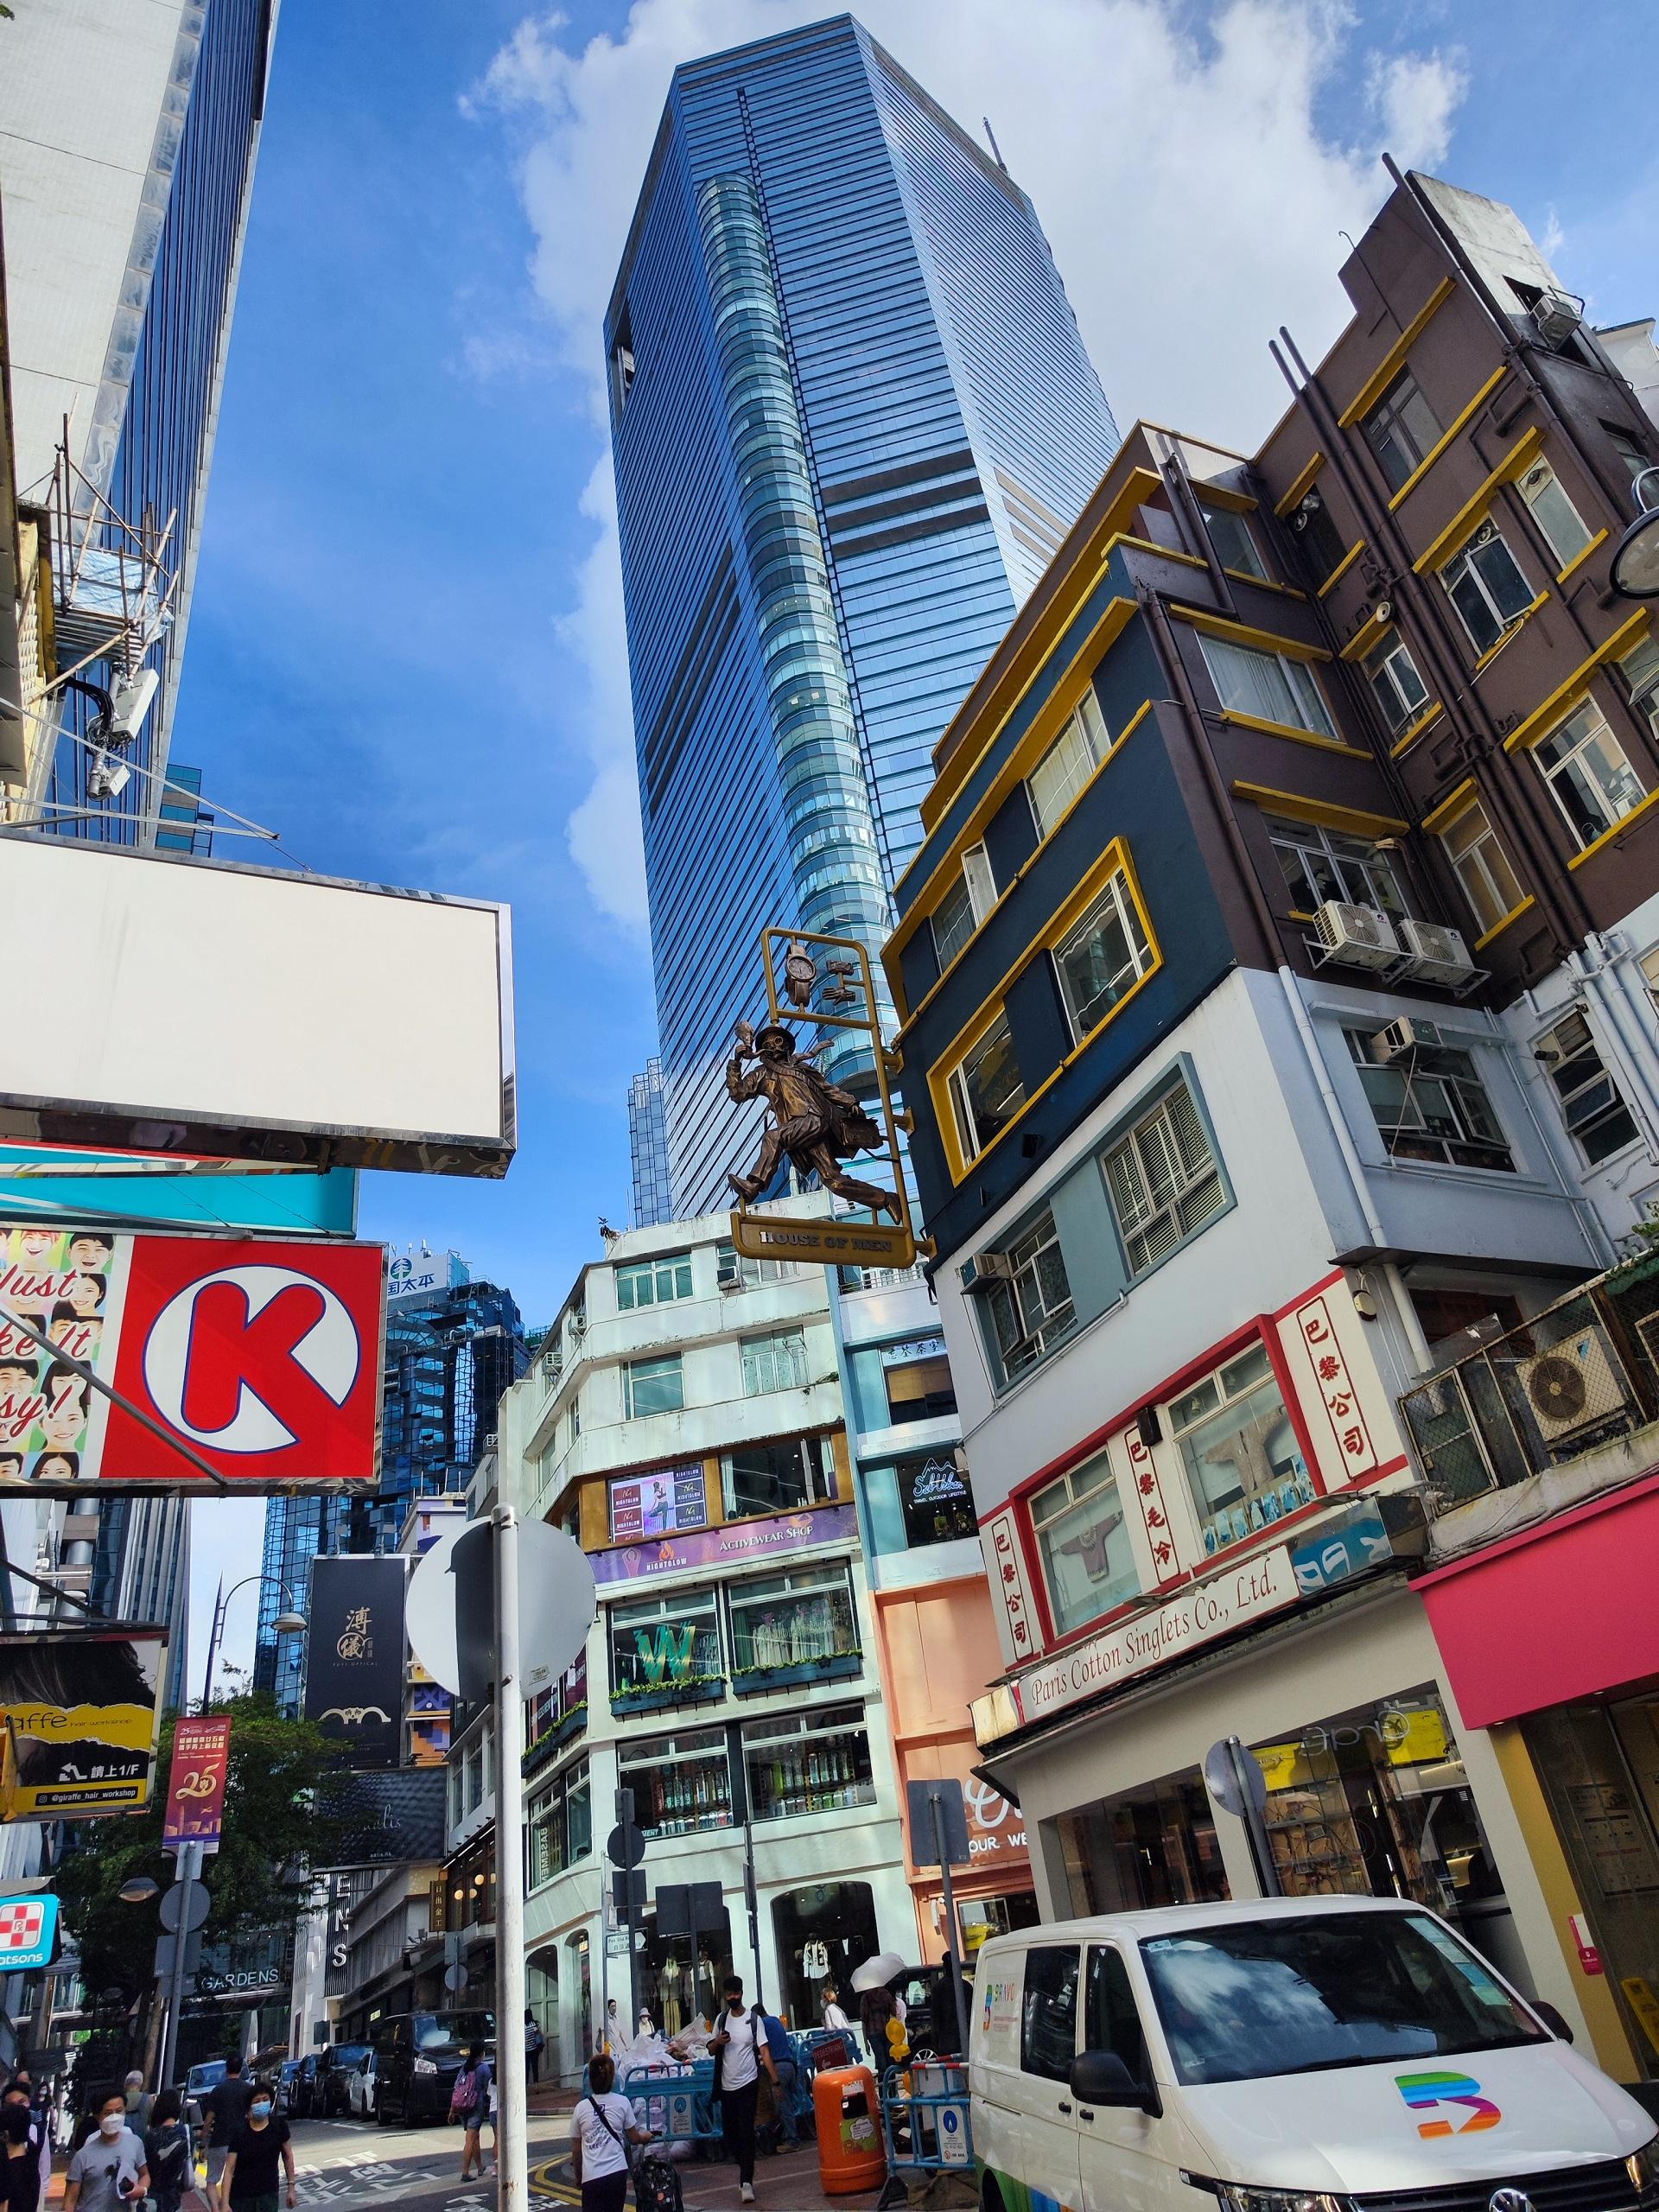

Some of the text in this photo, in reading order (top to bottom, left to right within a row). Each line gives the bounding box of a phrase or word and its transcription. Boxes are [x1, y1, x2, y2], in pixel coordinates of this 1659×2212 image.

[760, 1231, 892, 1252] HOUSE OF MEN
[168, 1275, 346, 1445] K
[1305, 1319, 1364, 1457] 巴黎公司
[0, 1384, 73, 1438] sy!
[1128, 1441, 1173, 1565] 巴黎毛冷
[719, 1531, 785, 1553] ACTIVEWEAR
[786, 1525, 814, 1539] SHOP
[995, 1534, 1027, 1643] 巴黎公司
[1032, 1669, 1068, 1707] Paris
[1070, 1647, 1122, 1687] Cotton
[1125, 1611, 1191, 1665] Singlets
[1195, 1595, 1230, 1630] Co.,
[1236, 1566, 1278, 1610] Ltd.
[13, 1712, 67, 1731] affe
[51, 1789, 137, 1803] @giraffe_hair_workshop
[175, 1763, 220, 1800] 25
[0, 1953, 44, 1966] atsons
[201, 1969, 279, 1989] GARDENS
